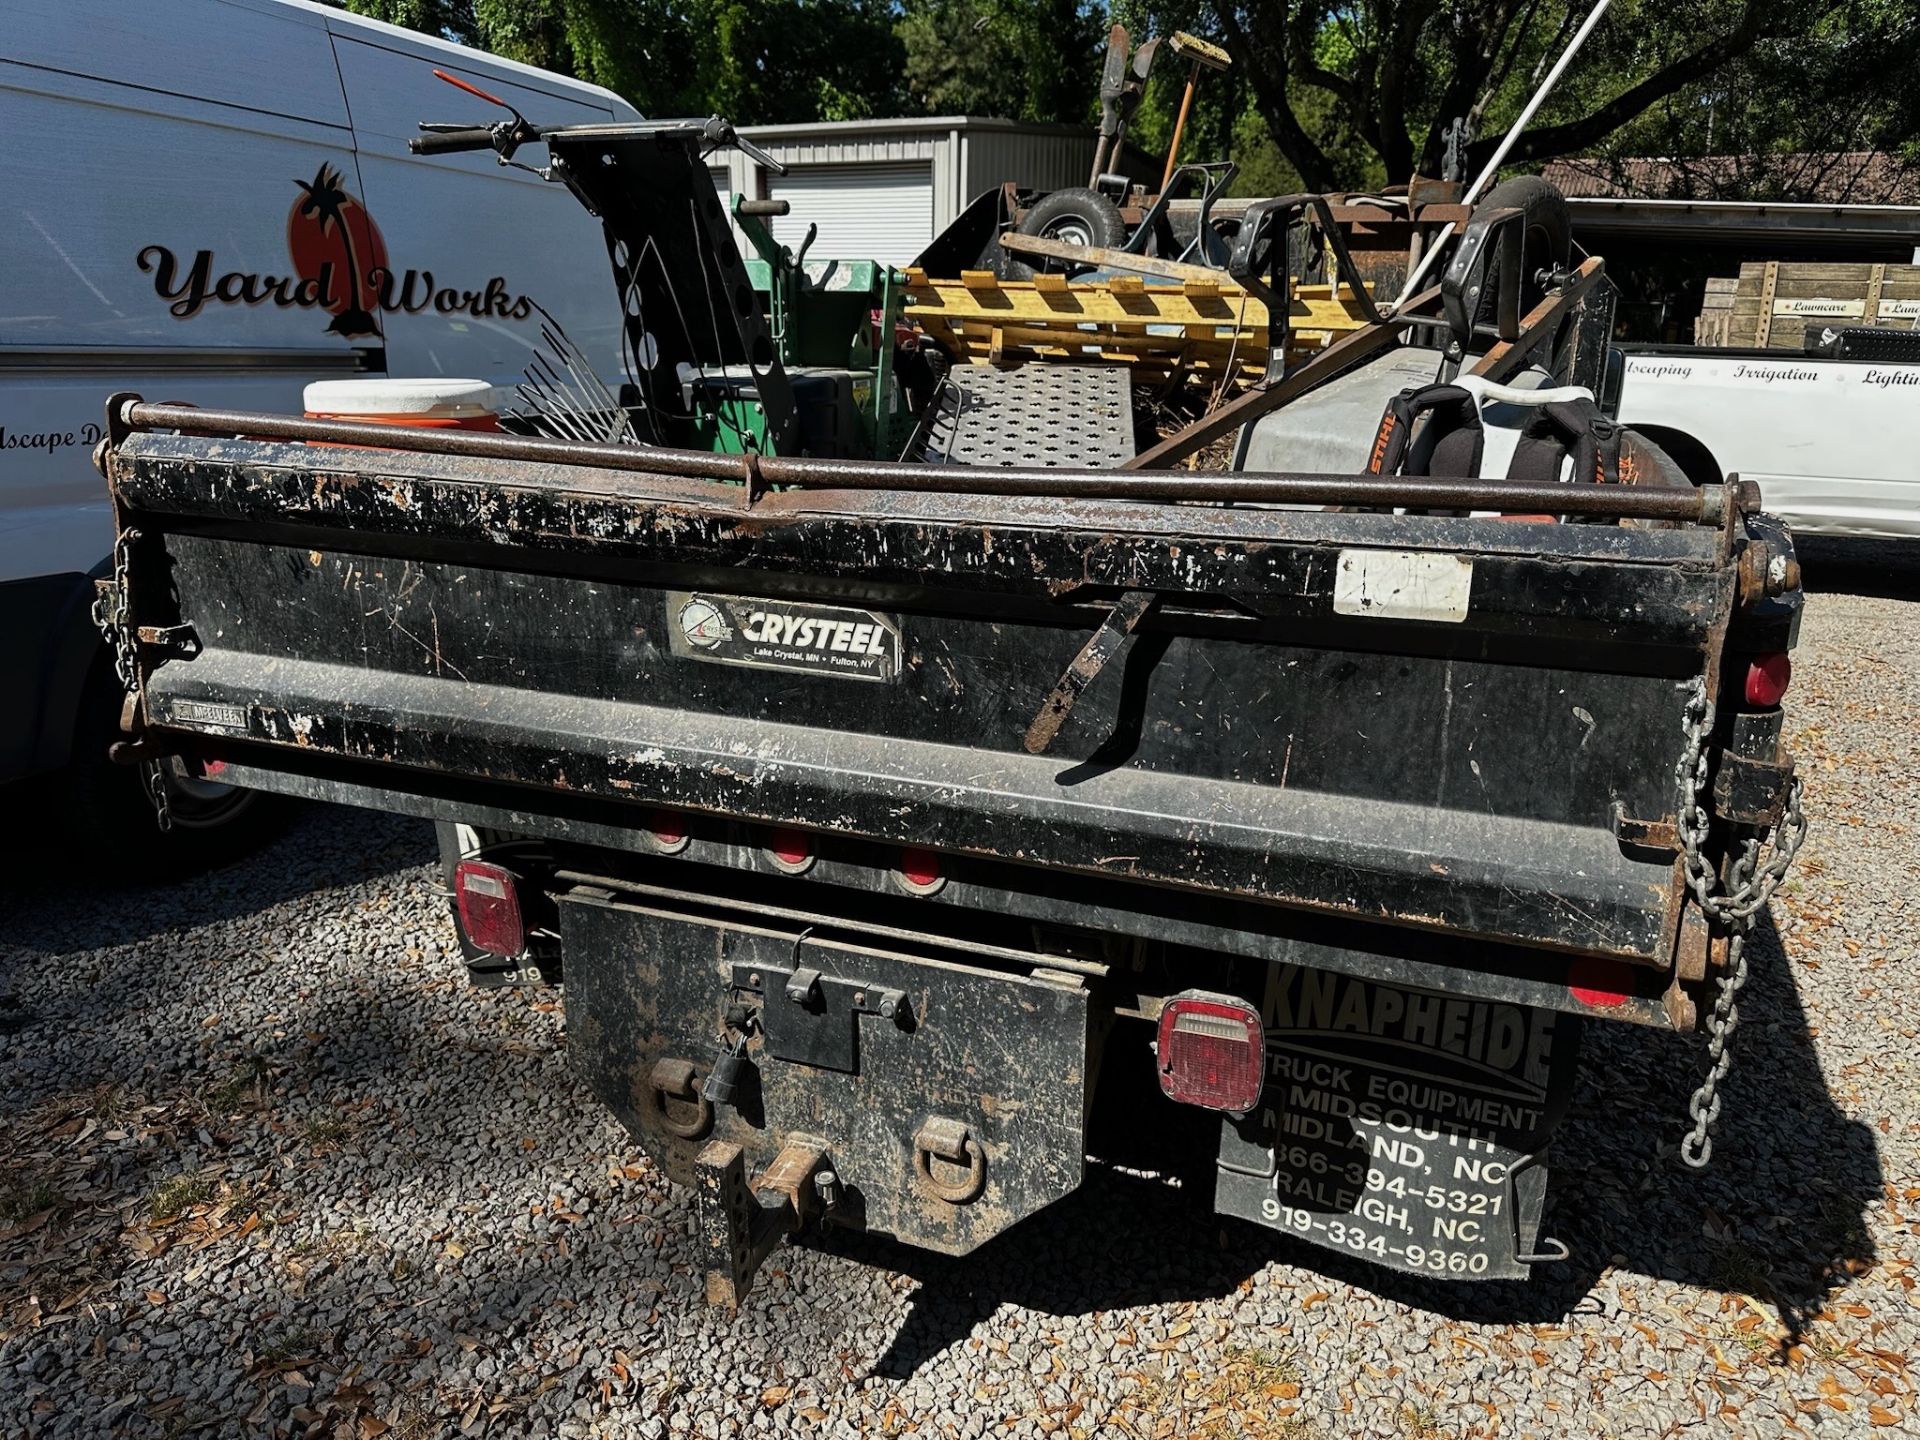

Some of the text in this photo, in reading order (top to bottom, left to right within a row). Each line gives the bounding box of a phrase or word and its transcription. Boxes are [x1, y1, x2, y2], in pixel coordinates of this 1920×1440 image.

[136, 244, 532, 320] Yard Works
[1792, 302, 1847, 311] Lawncare
[1734, 365, 1819, 383] Irrigation
[1371, 414, 1396, 475] STIHL
[743, 612, 886, 656] CRYSTEEL
[753, 647, 875, 669] Lake Crystal, MN Fulton, NY
[1261, 960, 1557, 1087] KNAPHEIDE
[1289, 1085, 1496, 1153] MIDSOUTH
[1368, 1074, 1544, 1131] EQUIPMENT
[1262, 1107, 1507, 1185] MIDLAND, NC
[1261, 1199, 1489, 1274] 919-334-9360
[1272, 1169, 1486, 1243] RALEIGH, NC.
